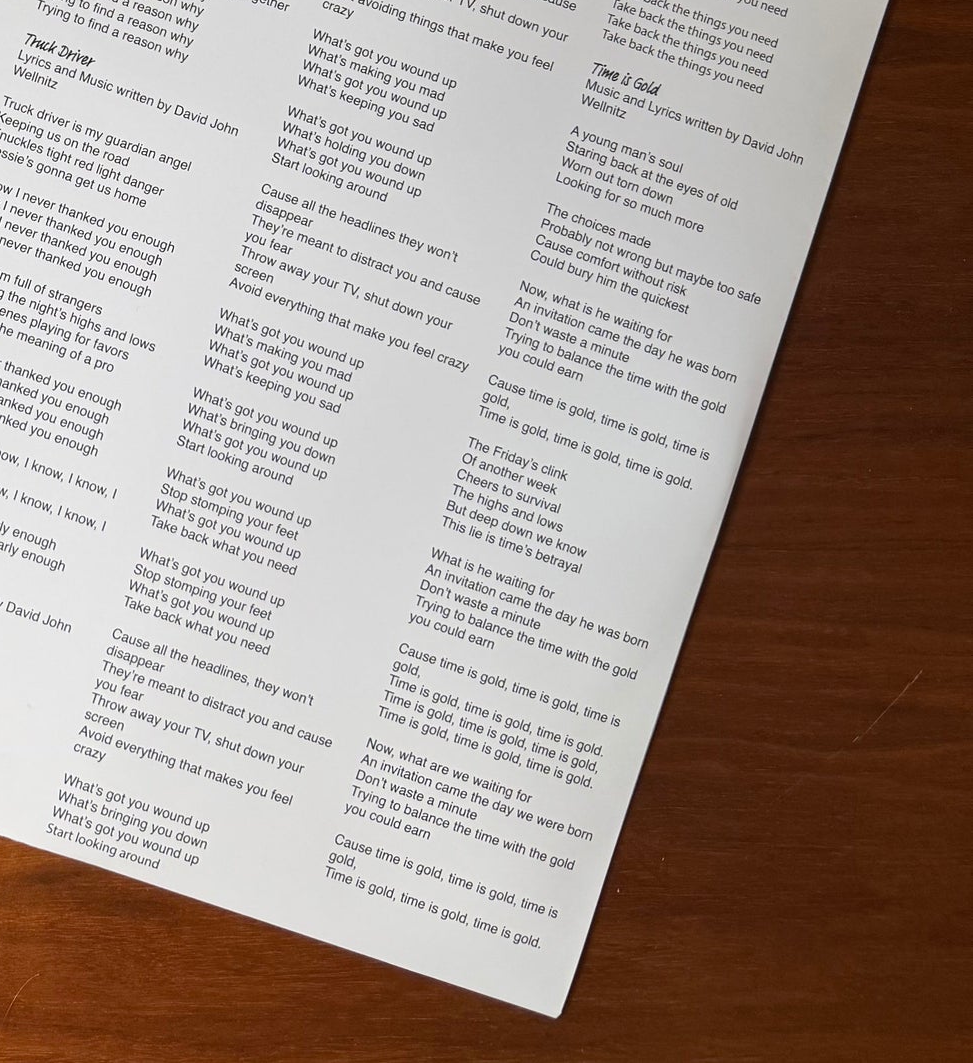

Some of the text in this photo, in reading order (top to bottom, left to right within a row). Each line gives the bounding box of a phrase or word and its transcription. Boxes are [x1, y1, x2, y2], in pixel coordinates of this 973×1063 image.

[760, 2, 789, 17] need
[24, 32, 96, 67] Truck Driver
[592, 62, 662, 96] Time is Gold
[582, 94, 627, 119] Wellnitz
[585, 78, 804, 165] Music and Lyrics written by David John
[46, 147, 72, 164] tight
[74, 158, 95, 171] red
[96, 163, 121, 182] light
[123, 174, 165, 196] danger
[271, 152, 389, 202] Start looking around
[562, 155, 673, 205] Worn out torn down
[14, 274, 32, 290] full
[33, 284, 47, 295] of
[48, 289, 103, 315] strangers
[29, 318, 72, 342] playing
[74, 332, 91, 346] for
[93, 338, 129, 360] favors
[228, 277, 470, 373] Avoid everything that make you feel crazy
[457, 468, 562, 514] Cheers to survival
[344, 803, 431, 840] you could earn
[46, 823, 161, 869] Start looking around
